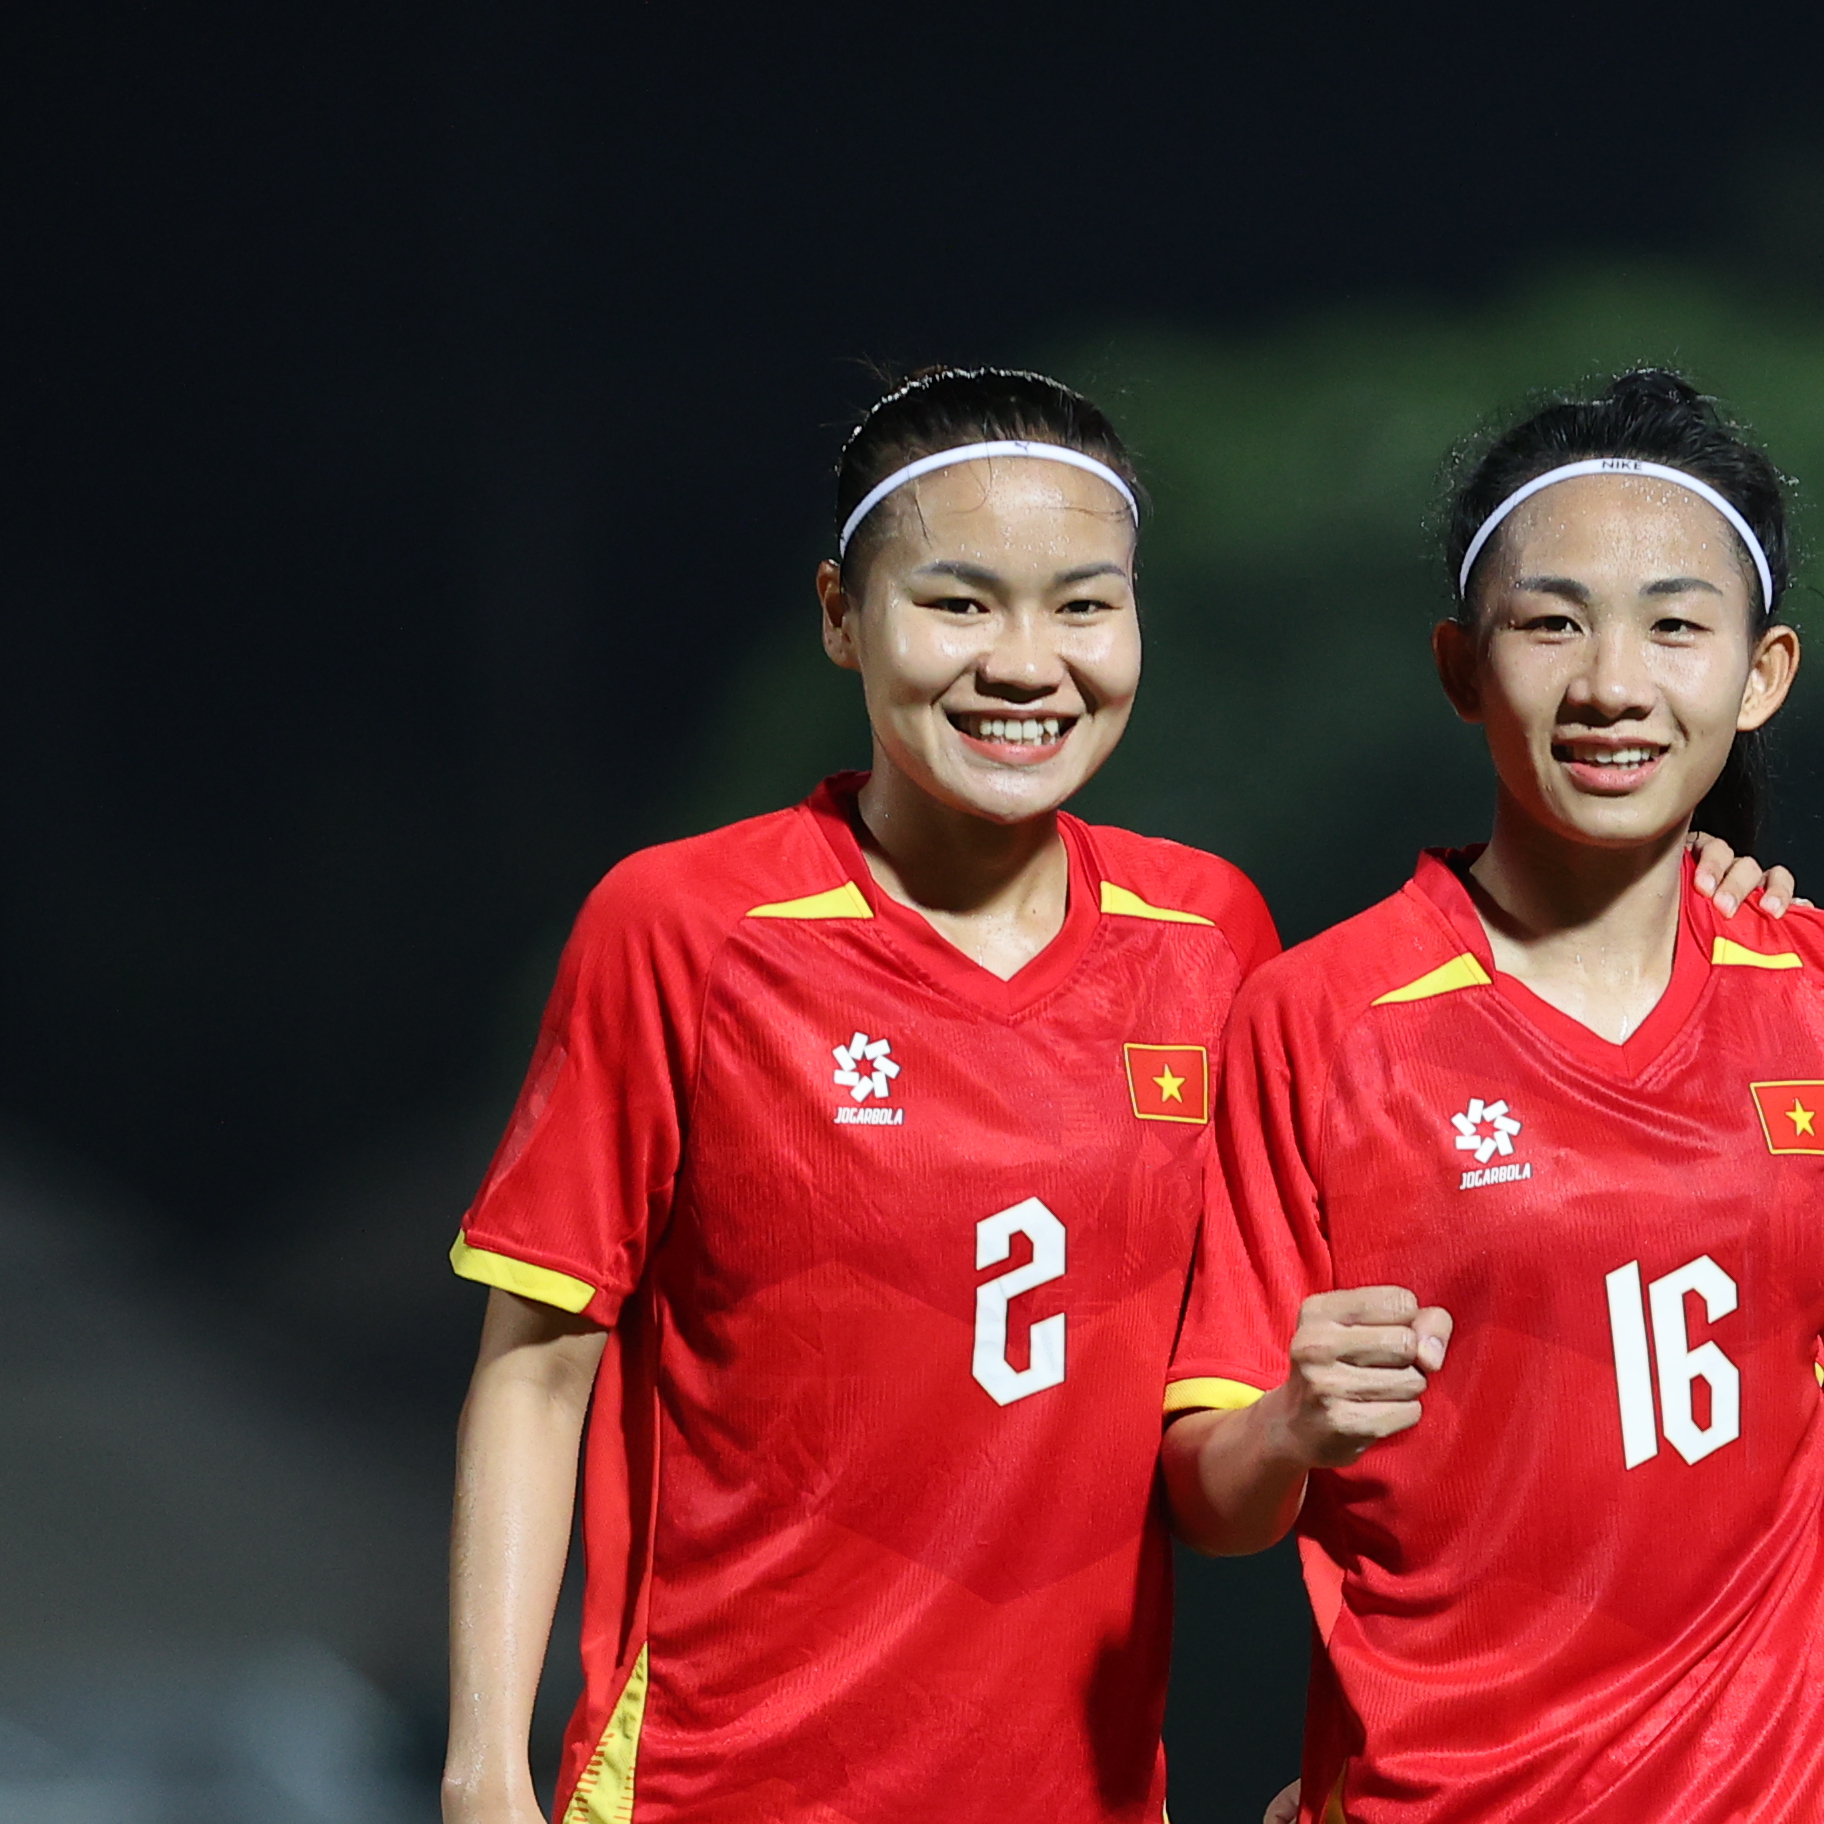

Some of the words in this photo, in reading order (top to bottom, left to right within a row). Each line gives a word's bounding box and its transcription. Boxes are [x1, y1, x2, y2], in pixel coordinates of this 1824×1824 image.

[1602, 460, 1643, 471] NIKE
[833, 1106, 905, 1126] JOGARBOLA
[1459, 1162, 1532, 1190] JOGARBOLA
[971, 1195, 1067, 1407] 2
[1604, 1253, 1741, 1471] 16
